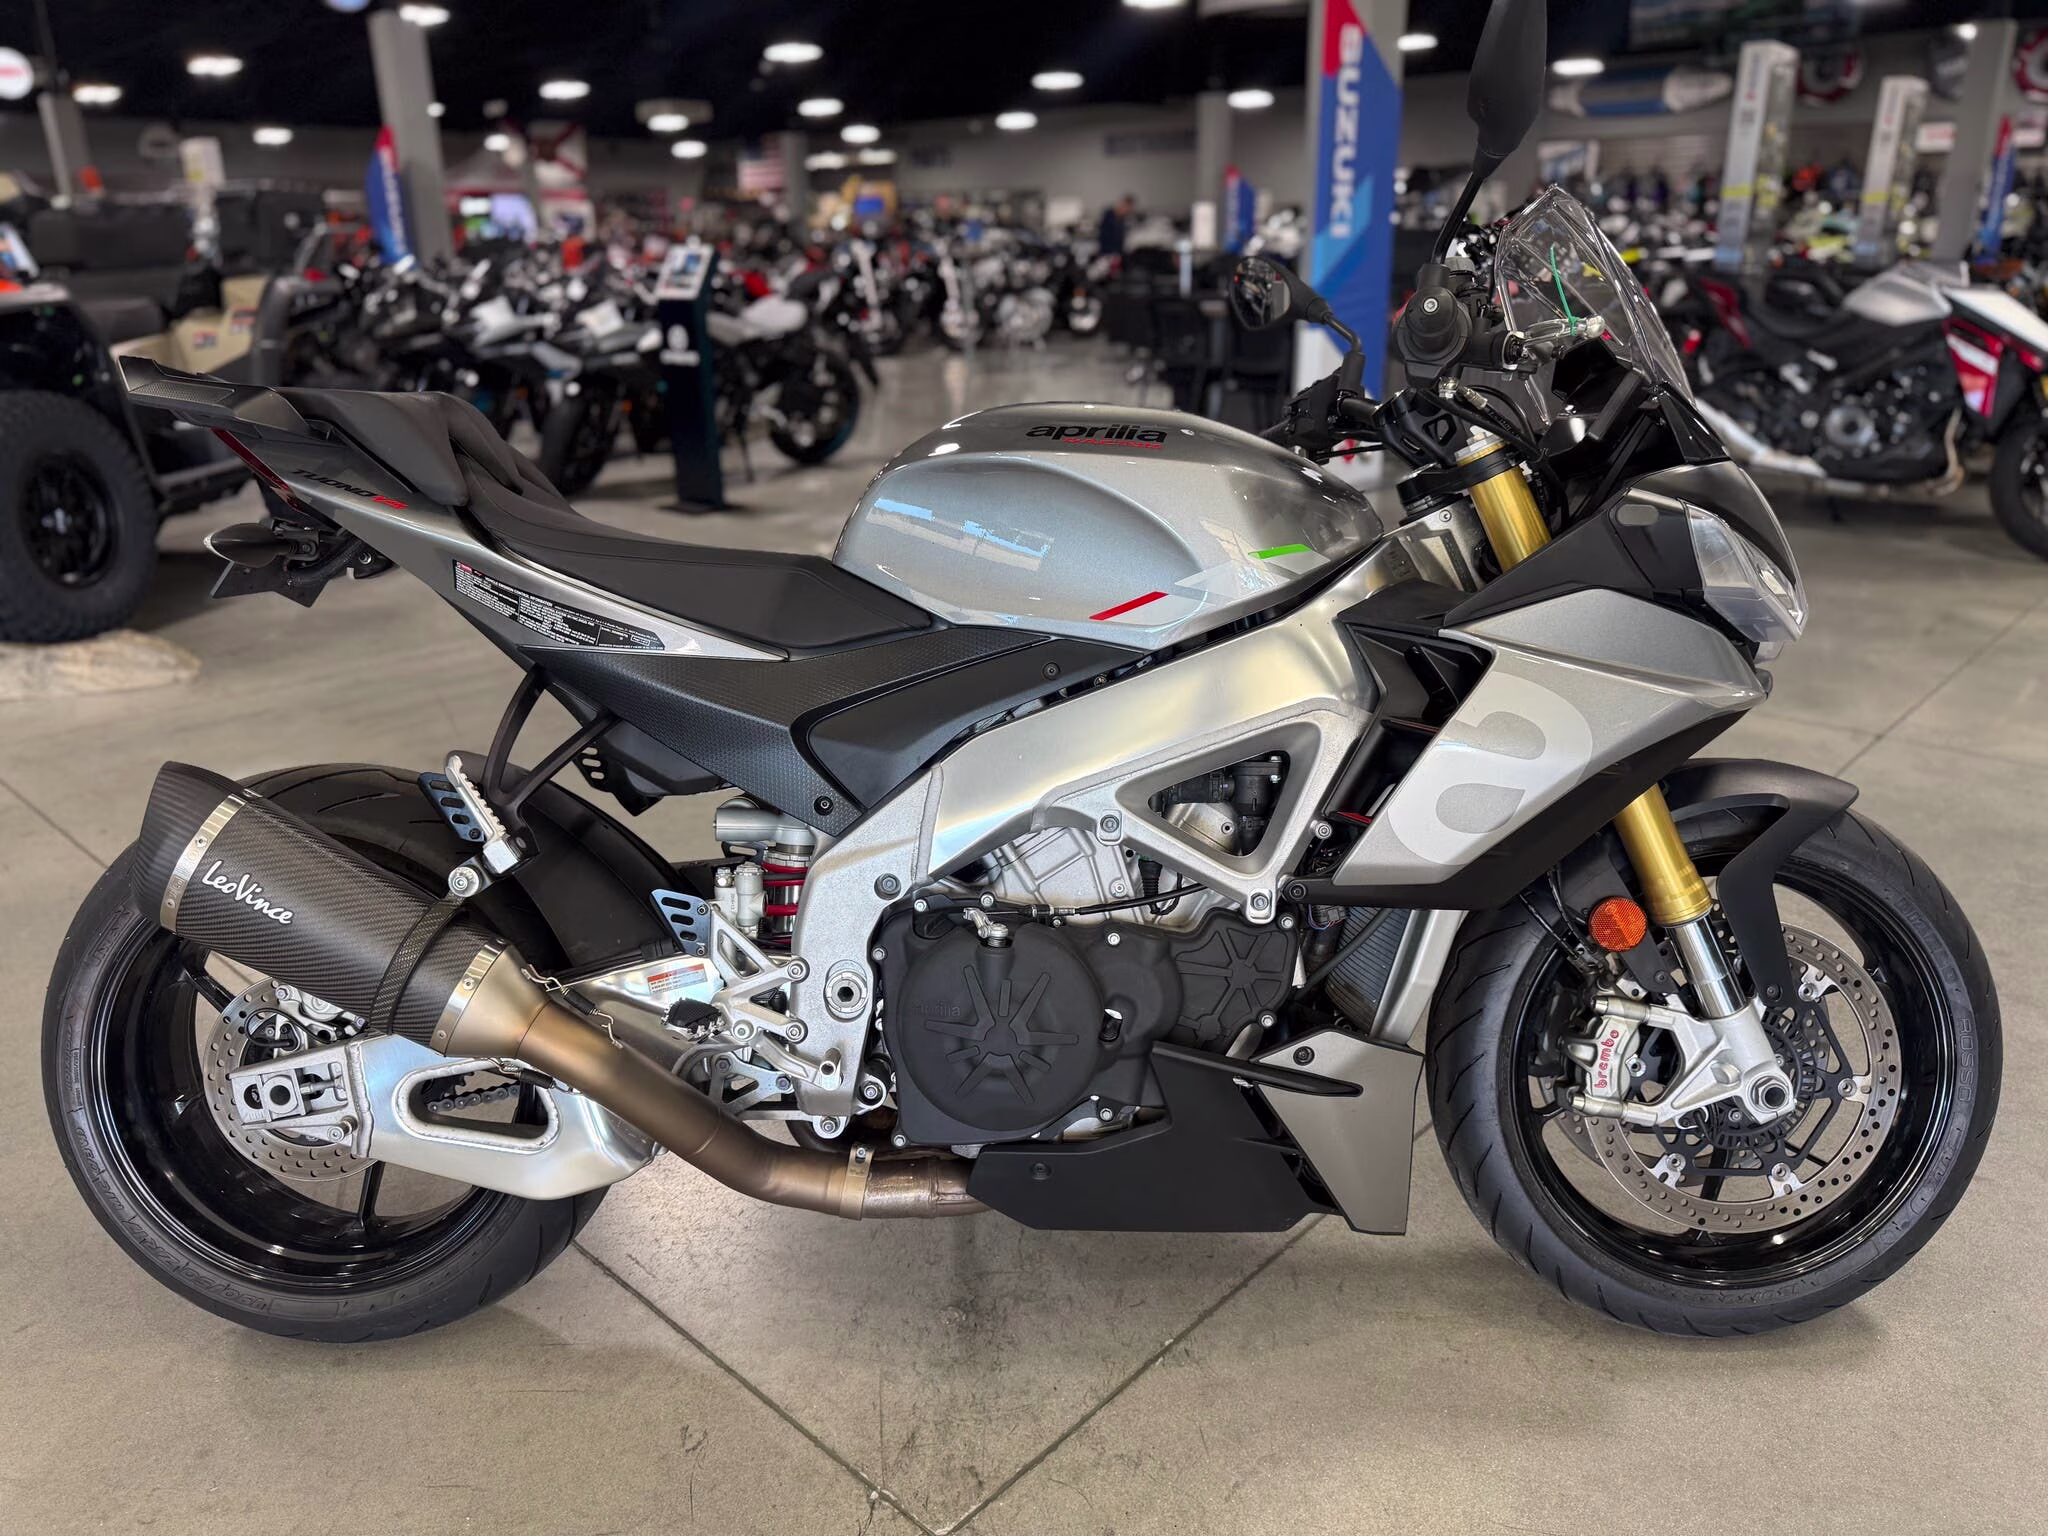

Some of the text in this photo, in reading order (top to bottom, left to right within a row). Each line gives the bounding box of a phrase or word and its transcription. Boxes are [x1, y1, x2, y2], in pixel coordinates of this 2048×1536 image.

[1329, 22, 1363, 238] SUZUKI
[1026, 424, 1168, 443] aprilia
[1062, 437, 1163, 450] RACING
[291, 469, 377, 497] TUONO
[202, 860, 293, 924] LeoVince
[1594, 1029, 1620, 1089] brembo
[1956, 1016, 1974, 1102] ROSSO
